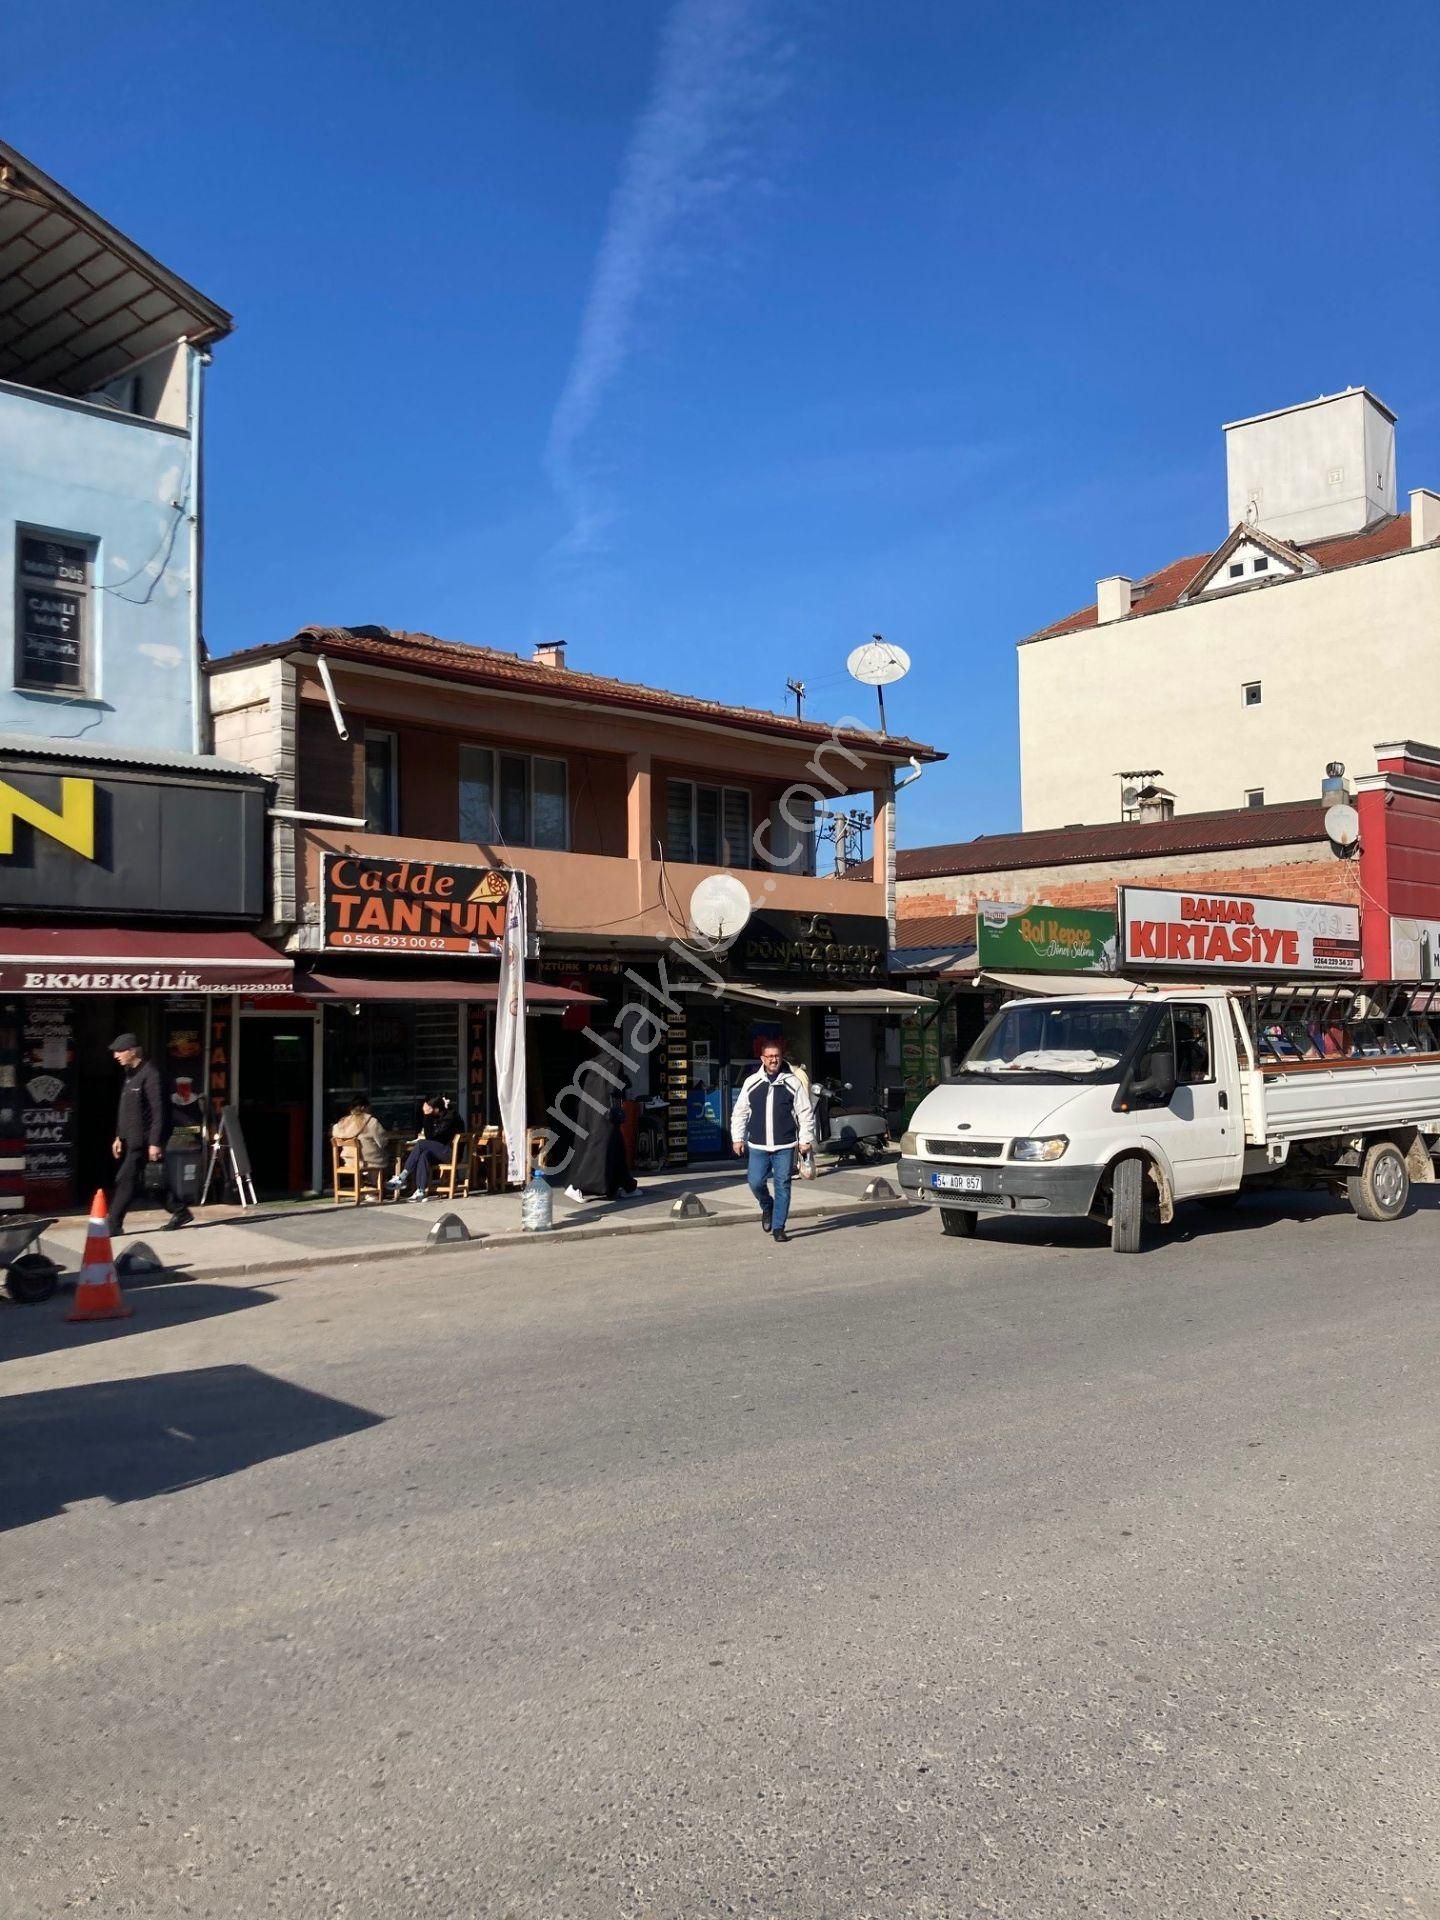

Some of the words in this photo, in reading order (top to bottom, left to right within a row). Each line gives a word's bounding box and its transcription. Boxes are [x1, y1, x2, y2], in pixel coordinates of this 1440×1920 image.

[34, 613, 71, 632] MAÇ
[331, 859, 455, 896] Cadde
[331, 894, 507, 936] TANTUN
[1180, 896, 1255, 925] BAHAR
[342, 934, 350, 944] 0
[355, 934, 380, 946] 546
[383, 936, 406, 947] 293
[409, 937, 426, 949] 00
[429, 938, 445, 949] 62
[1021, 918, 1045, 944] Bol
[23, 971, 202, 992] EKMEKÇİLİK
[25, 1126, 64, 1142] MAÇ
[937, 1175, 946, 1186] 54
[966, 1178, 980, 1189] 857
